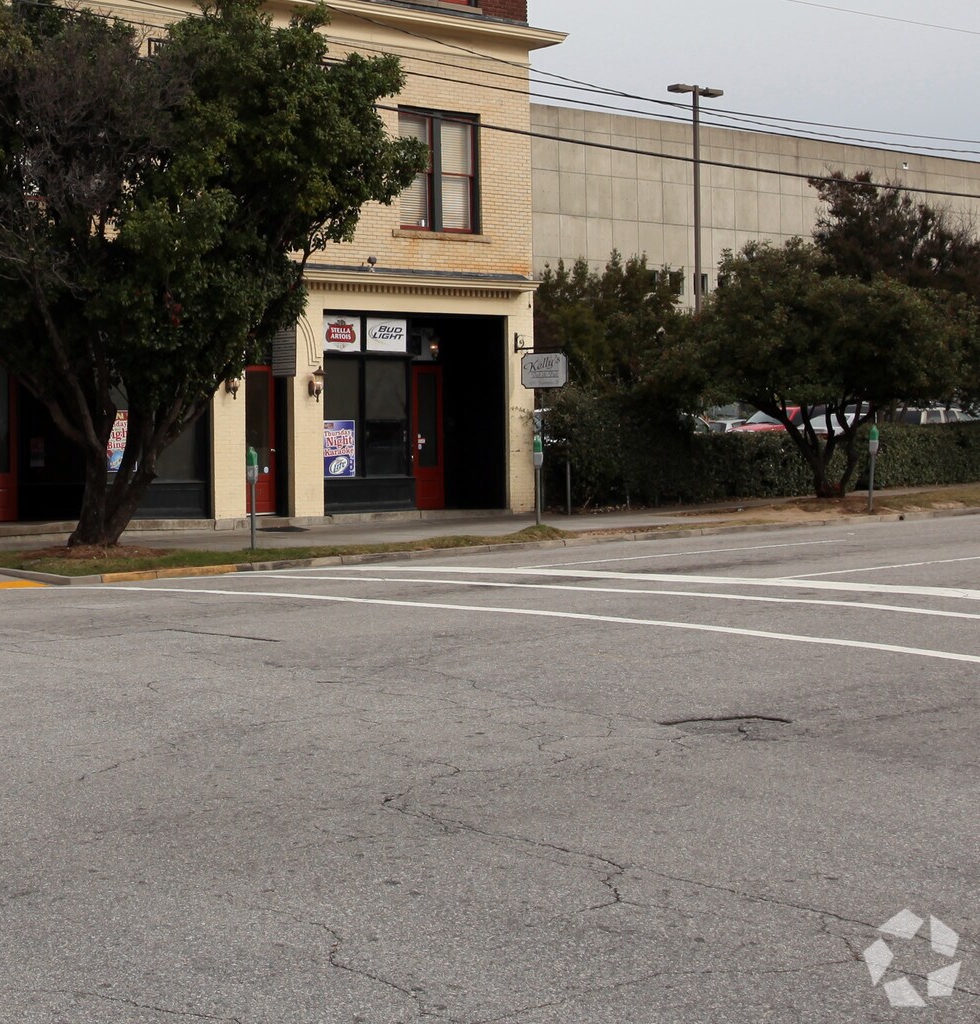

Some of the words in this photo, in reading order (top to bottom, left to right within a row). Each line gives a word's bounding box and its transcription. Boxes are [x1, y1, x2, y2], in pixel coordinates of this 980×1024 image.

[378, 325, 403, 334] BUD
[373, 332, 404, 340] LIGHT
[523, 355, 561, 373] Kelly's
[324, 429, 351, 437] Thursday
[326, 436, 353, 449] Night
[324, 447, 354, 456] Karaoke
